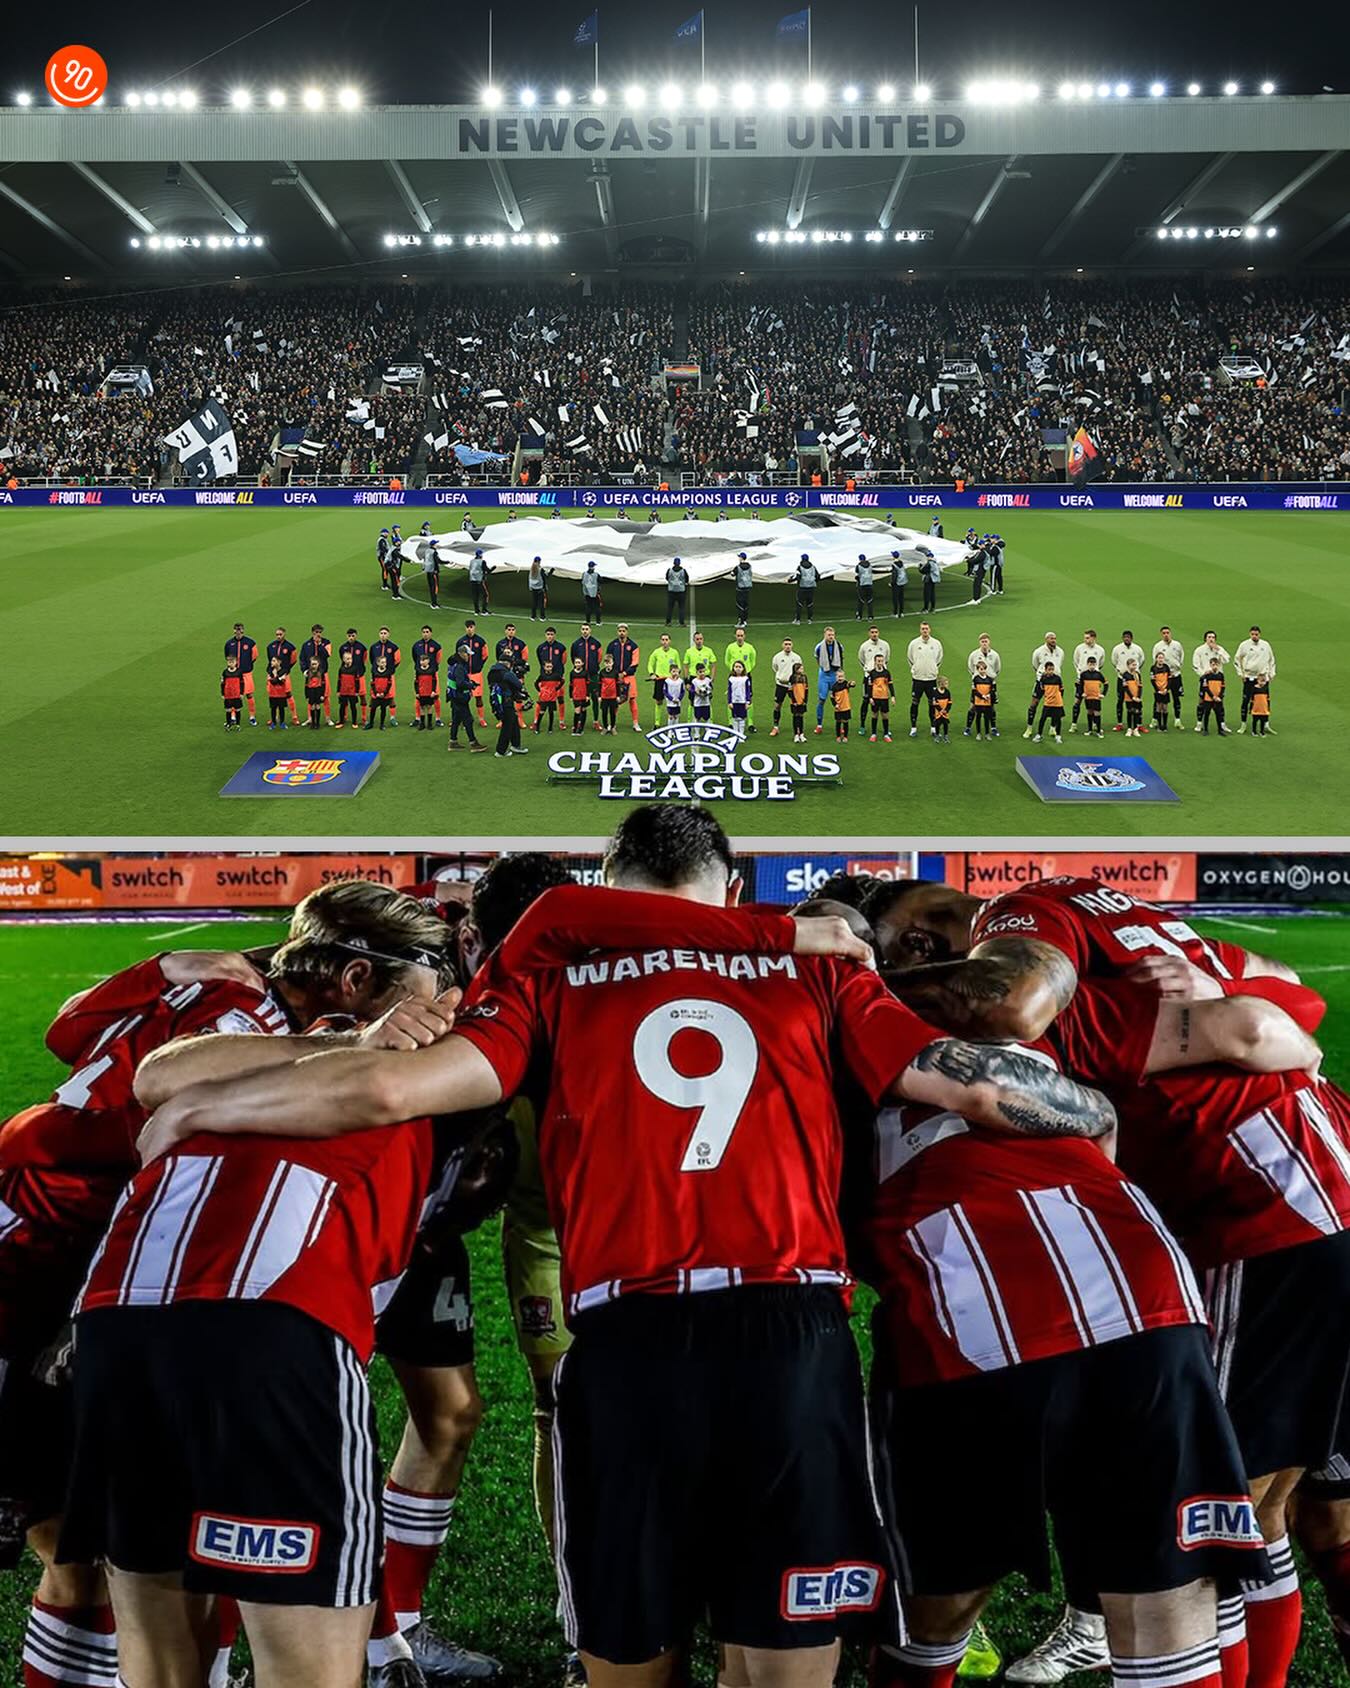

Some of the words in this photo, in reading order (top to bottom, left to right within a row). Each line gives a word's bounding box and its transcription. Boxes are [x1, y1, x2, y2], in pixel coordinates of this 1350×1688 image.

[458, 115, 757, 153] NEWCASTLE
[787, 113, 966, 149] UNITED
[48, 491, 102, 505] #FOOTBALL
[132, 493, 166, 504] UEFA
[284, 493, 318, 504] UEFA
[353, 491, 405, 505] #FOOTBALL
[435, 493, 469, 504] UEFA
[603, 493, 640, 505] UEFA
[642, 493, 722, 505] CHAMPIONS
[726, 493, 778, 505] LEAGUE
[908, 494, 942, 506] UEFA
[977, 494, 1030, 507] #FOOTBALL
[1060, 495, 1094, 506] UEFA
[1213, 495, 1248, 507] UEFA
[1284, 495, 1339, 508] #FOOTBALL
[649, 726, 741, 749] UEFA
[548, 751, 841, 775] CHAMPIONS
[598, 775, 796, 799] LEAGUE
[112, 866, 184, 887] switch
[216, 865, 288, 886] switch
[320, 864, 393, 884] switch
[967, 860, 1043, 881] switch
[1091, 859, 1168, 881] switch
[1203, 870, 1286, 884] OXYGEN
[566, 949, 798, 988] WAREHAM
[633, 998, 759, 1172] 9
[1187, 1503, 1261, 1537] EM
[204, 1519, 307, 1561] EMS
